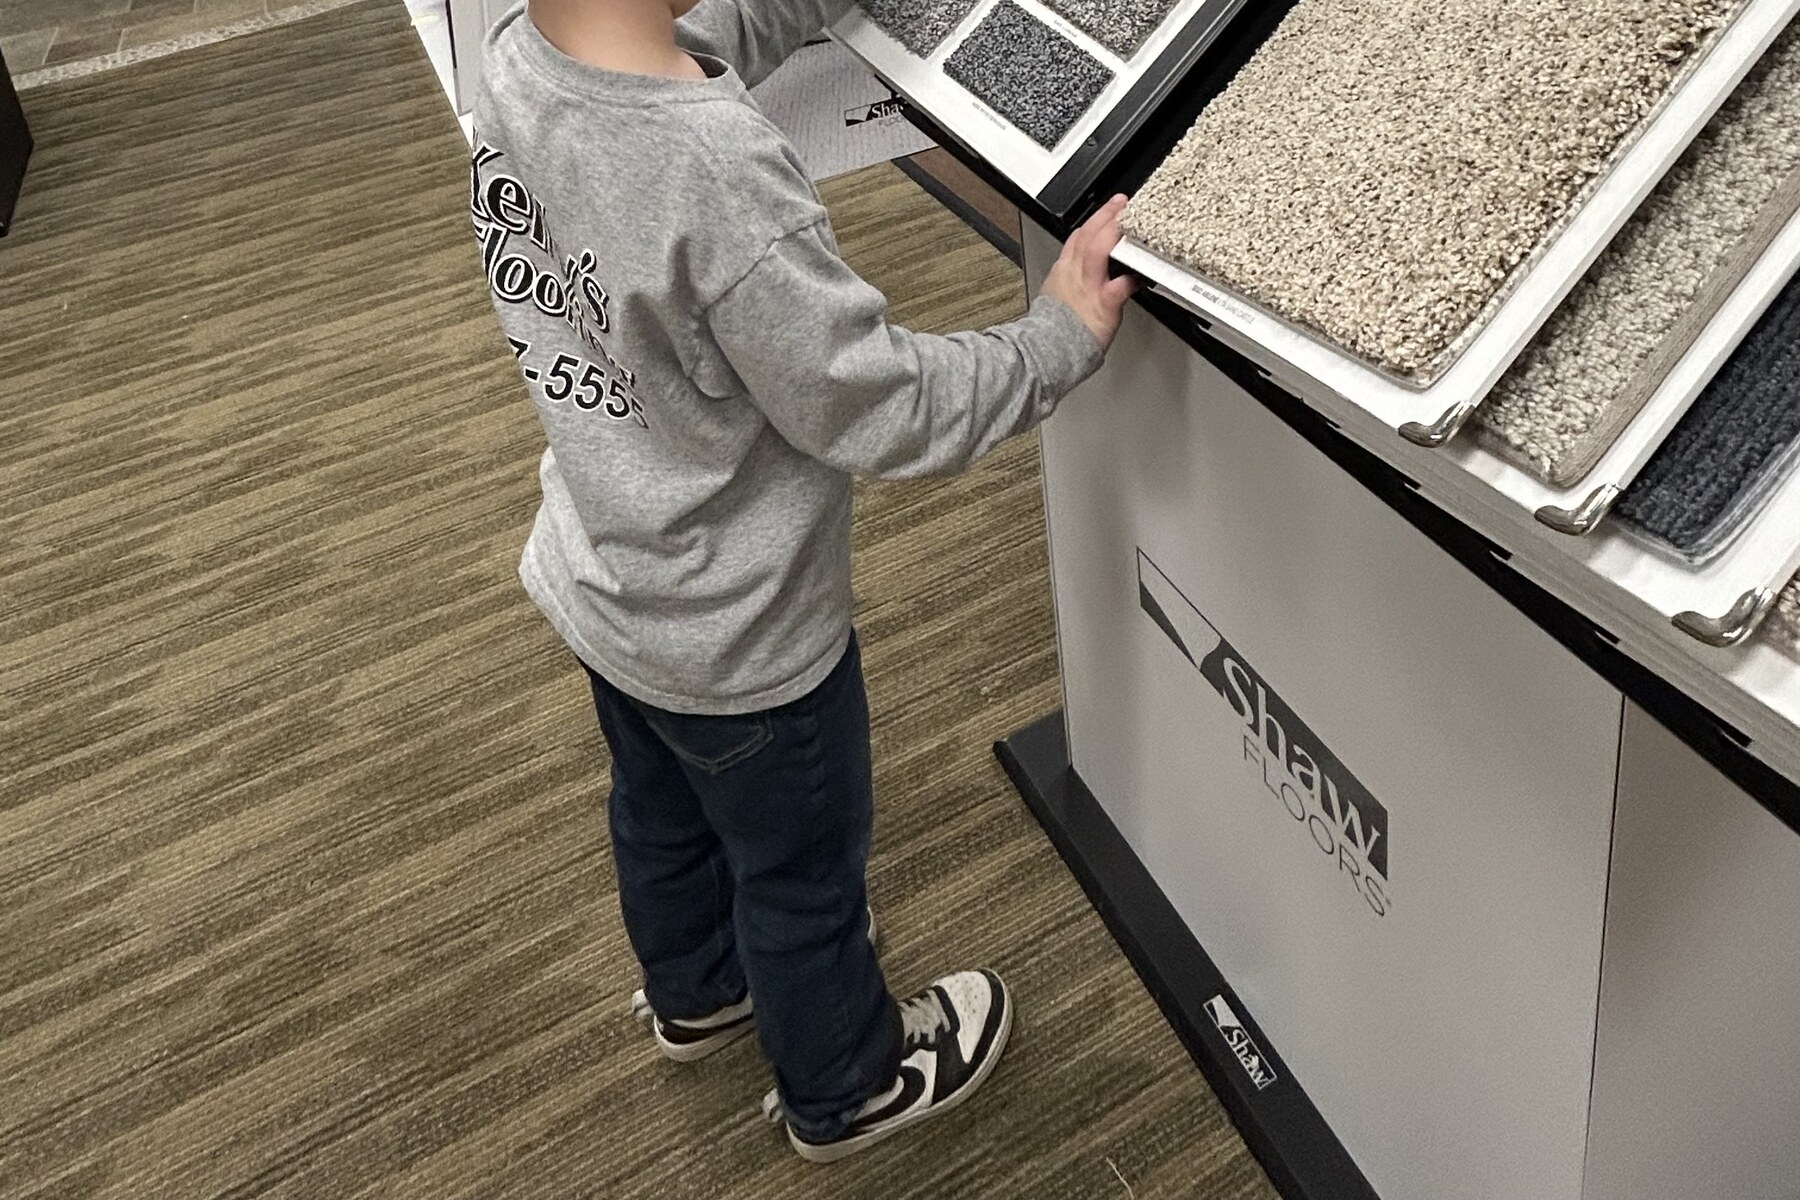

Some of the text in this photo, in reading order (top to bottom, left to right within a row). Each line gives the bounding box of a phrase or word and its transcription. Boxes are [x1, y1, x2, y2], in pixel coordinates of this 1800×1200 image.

[1223, 657, 1381, 856] Shaw
[1243, 734, 1386, 917] FLOORS
[1225, 1029, 1270, 1086] Shaw
